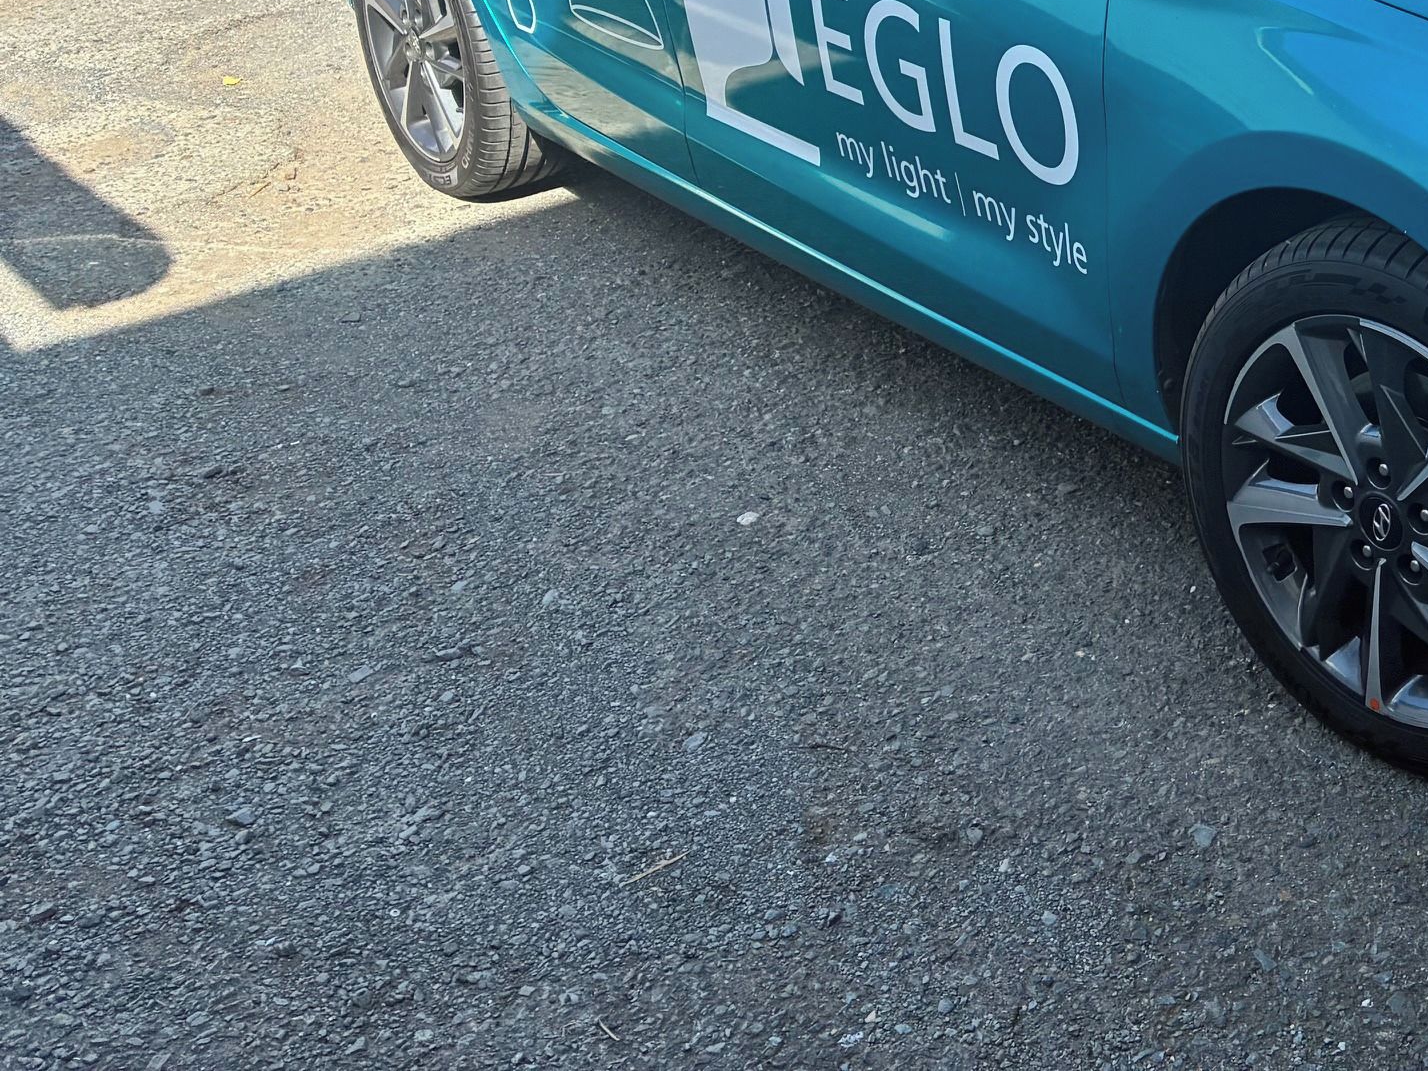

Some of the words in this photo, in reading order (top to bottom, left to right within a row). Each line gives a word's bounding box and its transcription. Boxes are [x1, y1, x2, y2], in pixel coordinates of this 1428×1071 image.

[835, 131, 874, 179] my
[880, 140, 952, 205] light
[973, 189, 1016, 241] my
[1026, 214, 1088, 275] style
